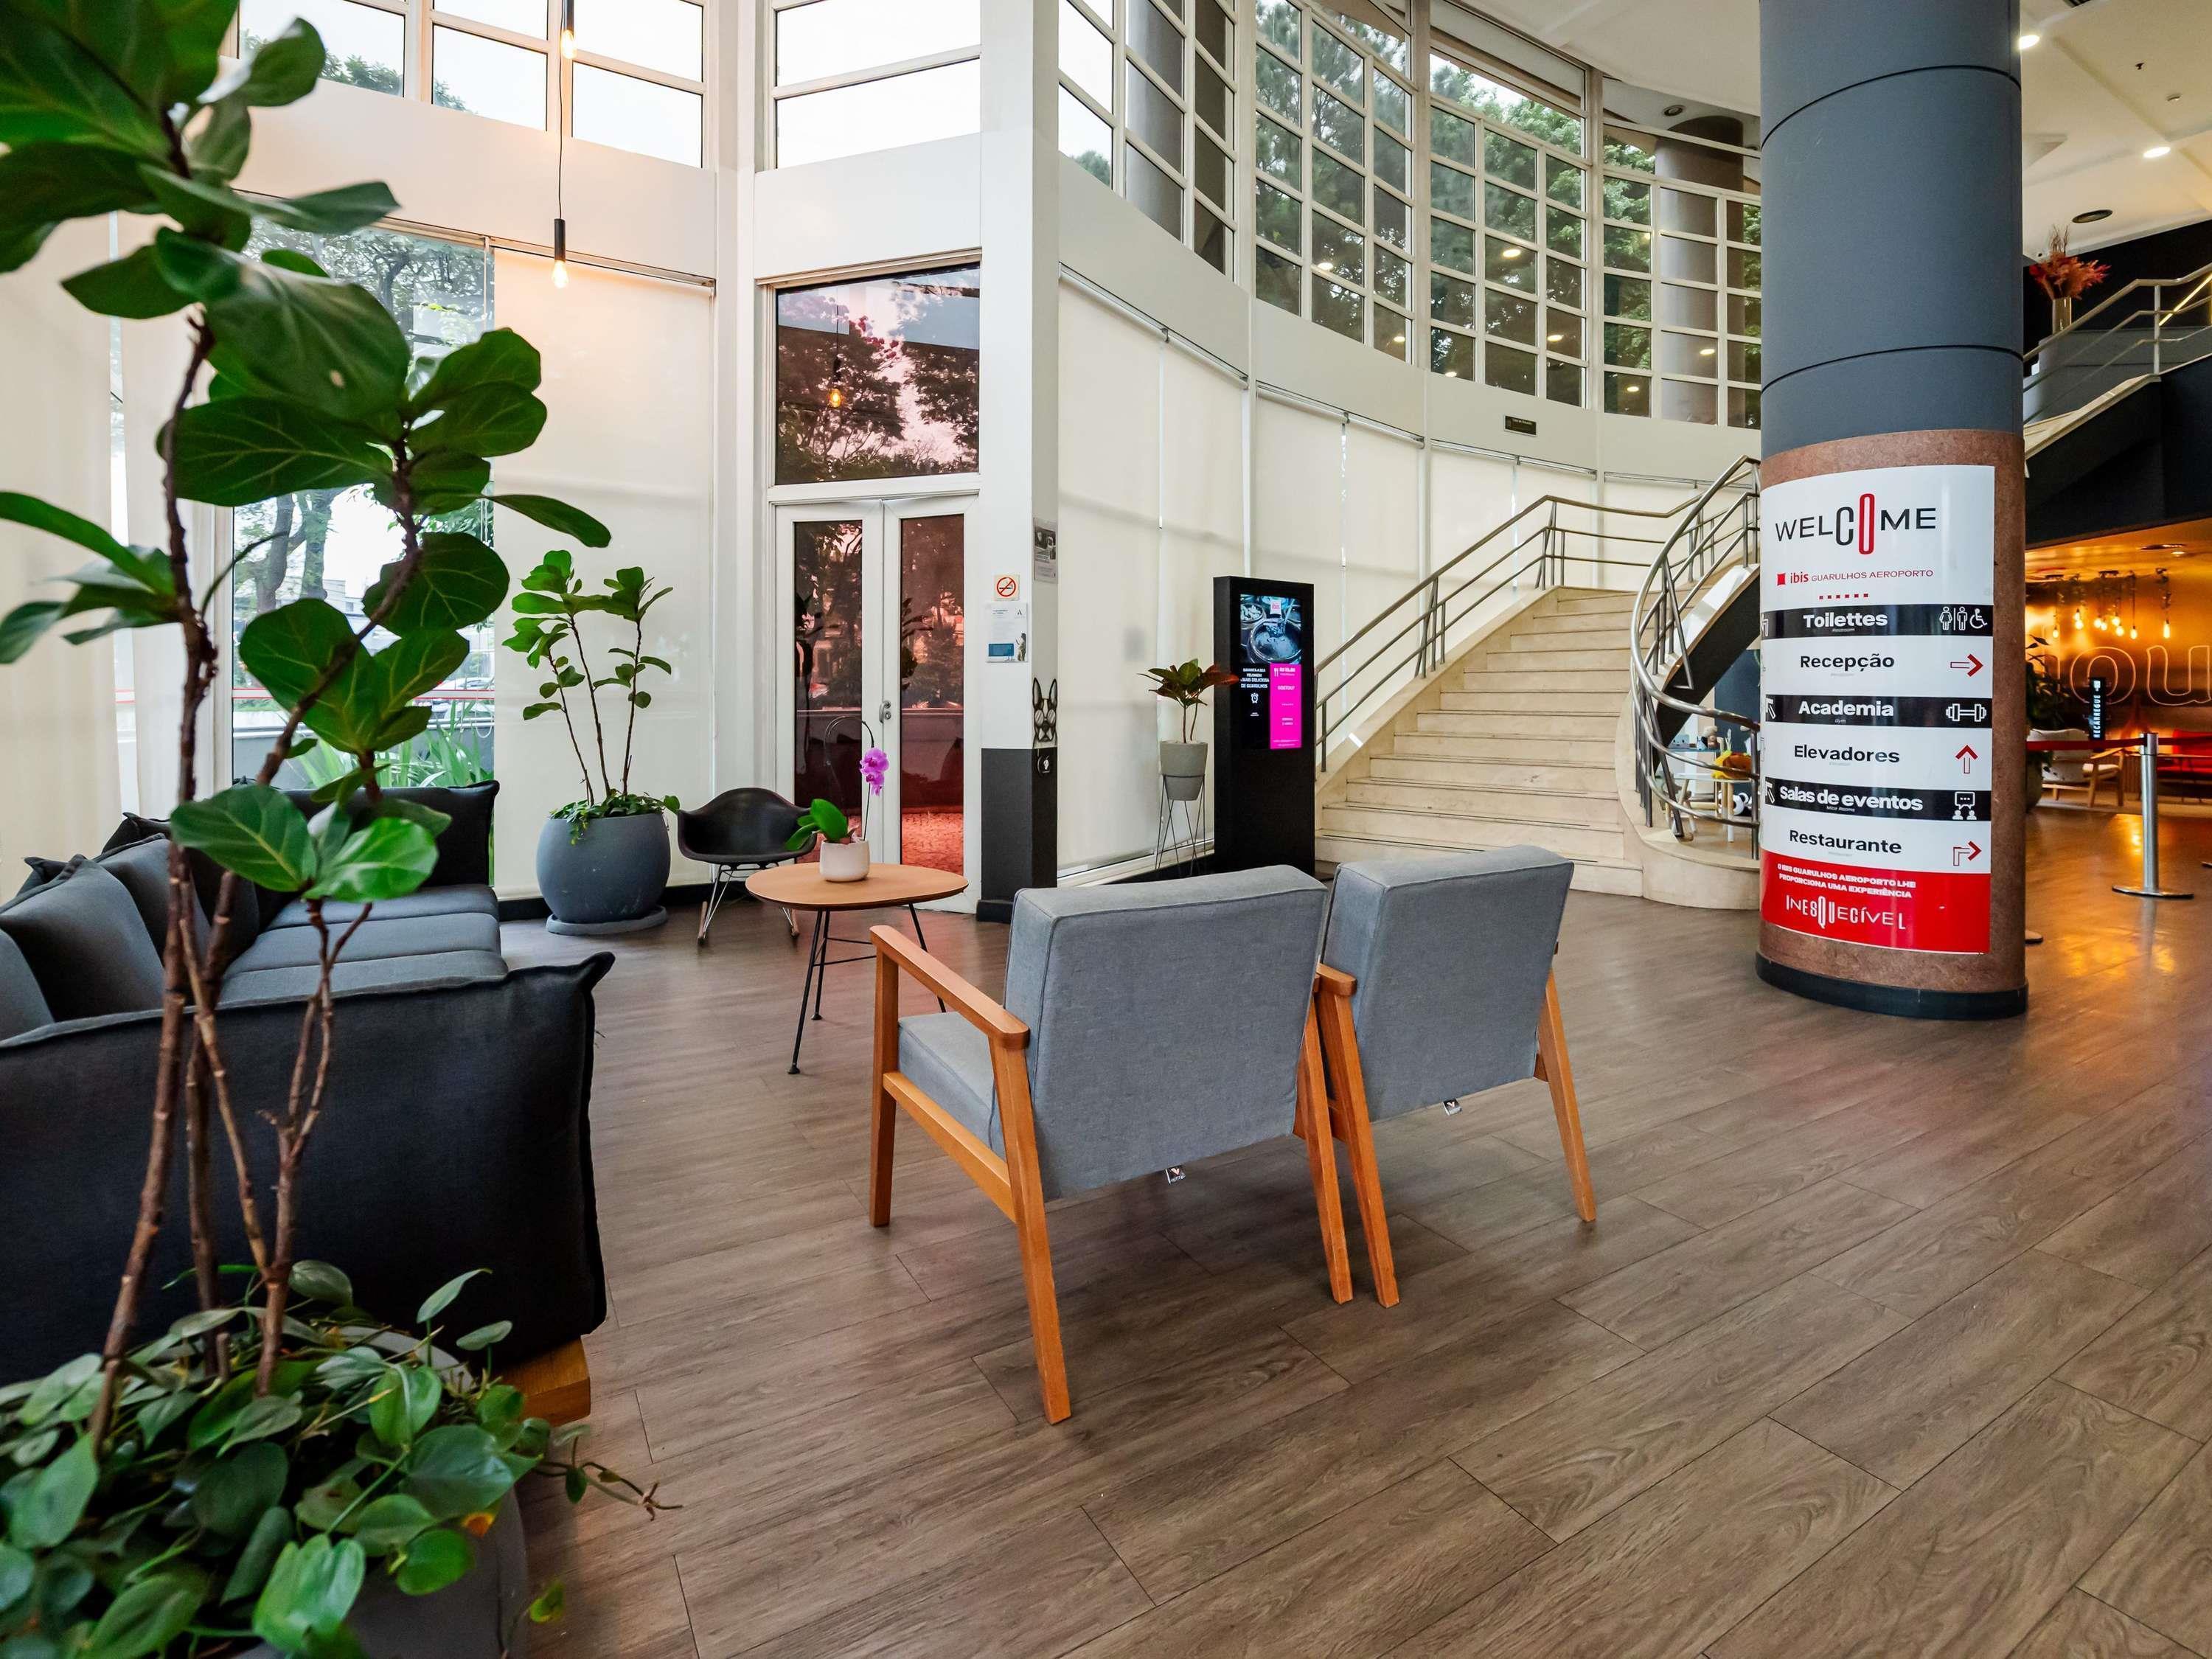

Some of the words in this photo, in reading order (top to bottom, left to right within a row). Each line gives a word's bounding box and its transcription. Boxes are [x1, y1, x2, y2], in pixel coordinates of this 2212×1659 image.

[1775, 493, 1937, 555] WELCOME
[1790, 571, 1809, 584] ibis
[1811, 571, 1868, 582] GUARULHOS
[1868, 569, 1934, 580] AEROPORTO
[1803, 611, 1888, 628] Toilettes
[1800, 653, 1896, 672] Recepção
[1798, 700, 1894, 717] Academia
[1793, 744, 1900, 763] Elevadores
[1779, 786, 1815, 804] Salas
[1816, 789, 1840, 806] de
[1841, 794, 1924, 811] eventos
[1789, 830, 1902, 855] Restaurante
[1778, 873, 1827, 888] PROPORCIONA
[1827, 882, 1848, 892] UMA
[1848, 886, 1913, 899] EXPERIÊNCIA
[1792, 867, 1838, 880] GUARULHOS
[1838, 874, 1896, 888] AEROPORTO
[1896, 879, 1916, 888] LHE
[1786, 894, 1907, 930] INESQUECÍVEL
